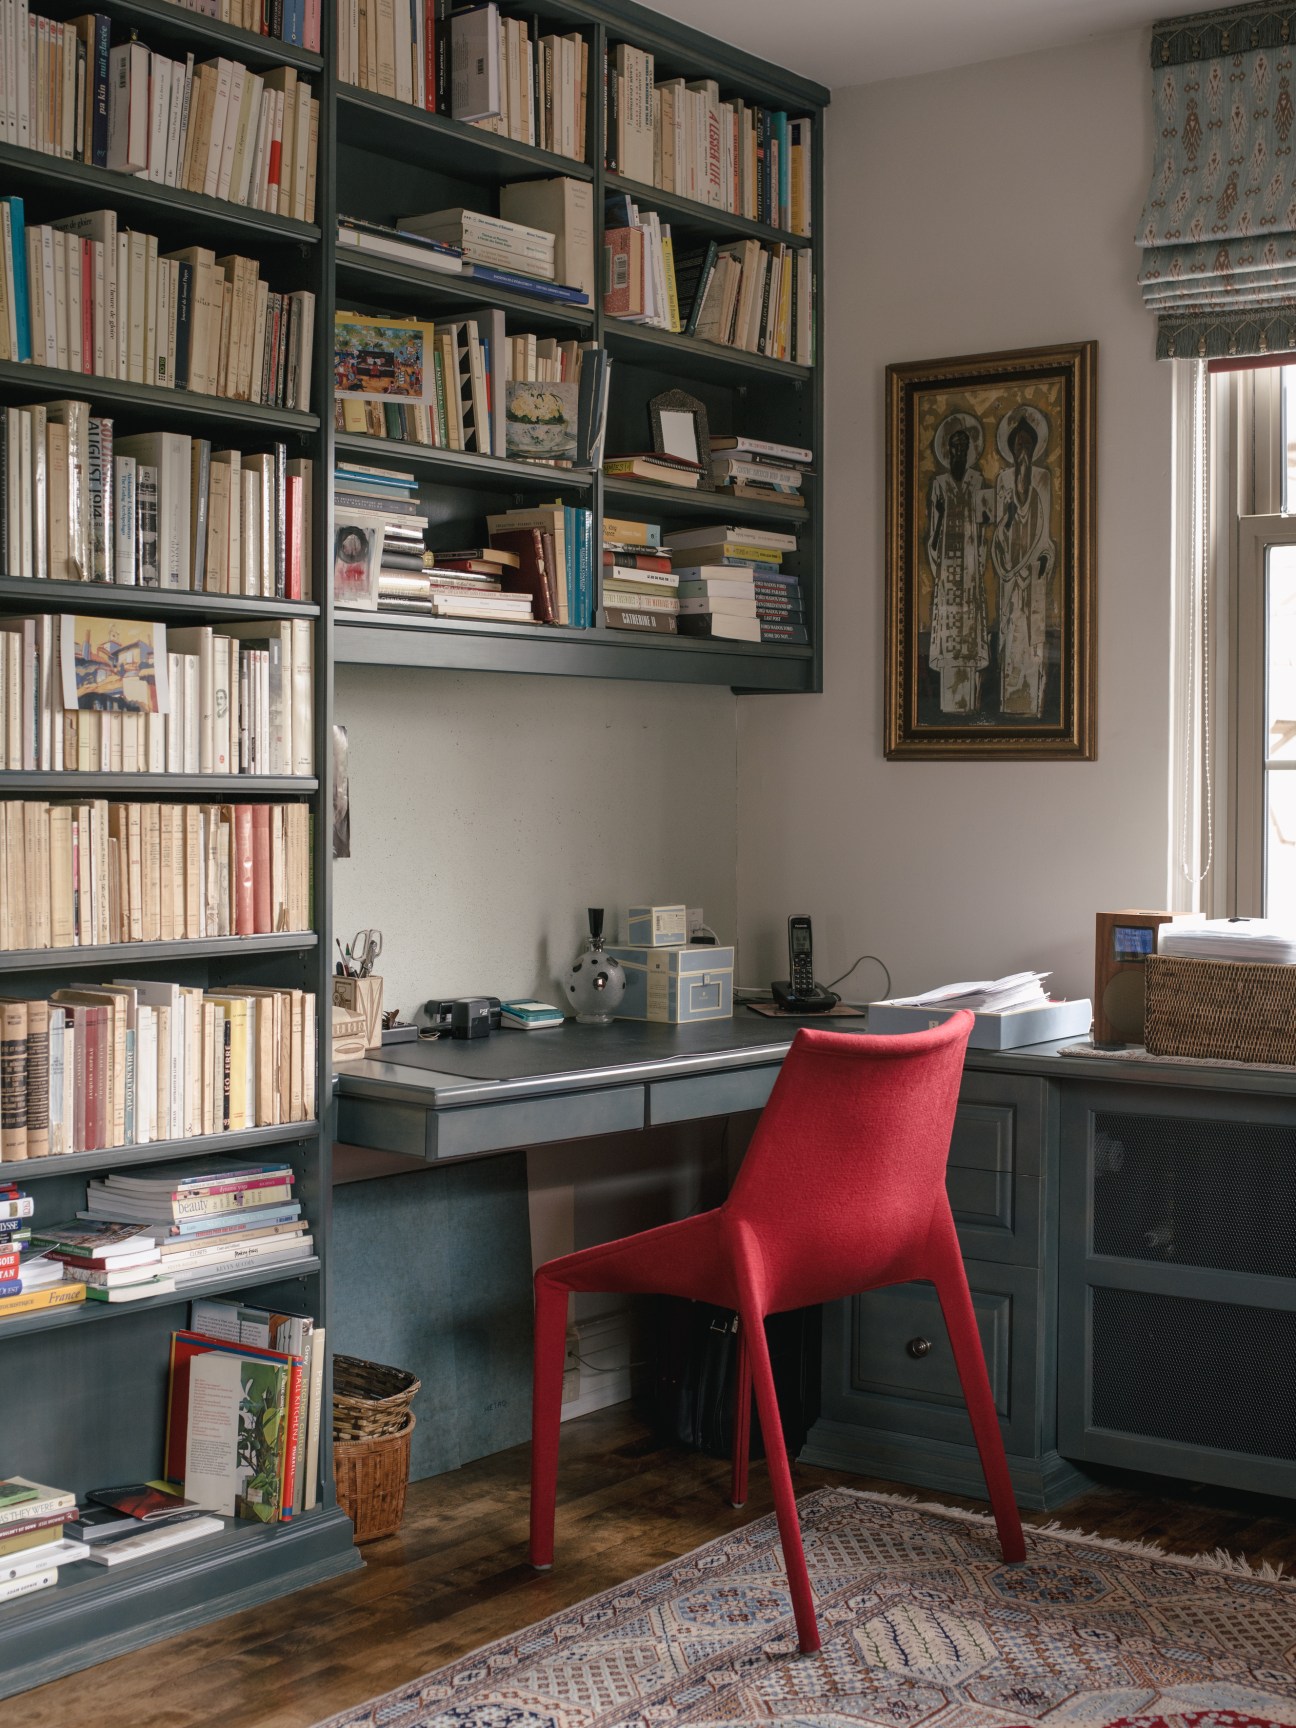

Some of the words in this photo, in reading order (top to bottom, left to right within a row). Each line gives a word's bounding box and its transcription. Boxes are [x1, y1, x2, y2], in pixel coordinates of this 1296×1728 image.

[100, 25, 108, 56] glacée
[99, 55, 107, 78] nuit
[98, 84, 107, 103] kin
[99, 104, 107, 115] pa
[708, 110, 719, 124] A
[709, 122, 720, 163] LESSER
[709, 162, 721, 190] LIFE
[88, 420, 101, 486] AUGUST
[621, 612, 650, 627] CATHERINE
[126, 1050, 134, 1112] APOLLINAIRE
[177, 1199, 208, 1215] beauty
[48, 1290, 81, 1304] France
[303, 1344, 311, 1365] Grey
[314, 1370, 323, 1397] Paris
[301, 1378, 309, 1421] kitchen
[291, 1395, 301, 1443] KITCHENS
[312, 1398, 321, 1441] Interiors
[297, 1422, 305, 1462] culture
[10, 1509, 32, 1521] THEY
[32, 1501, 55, 1515] WERE
[7, 1587, 20, 1595] ADAM
